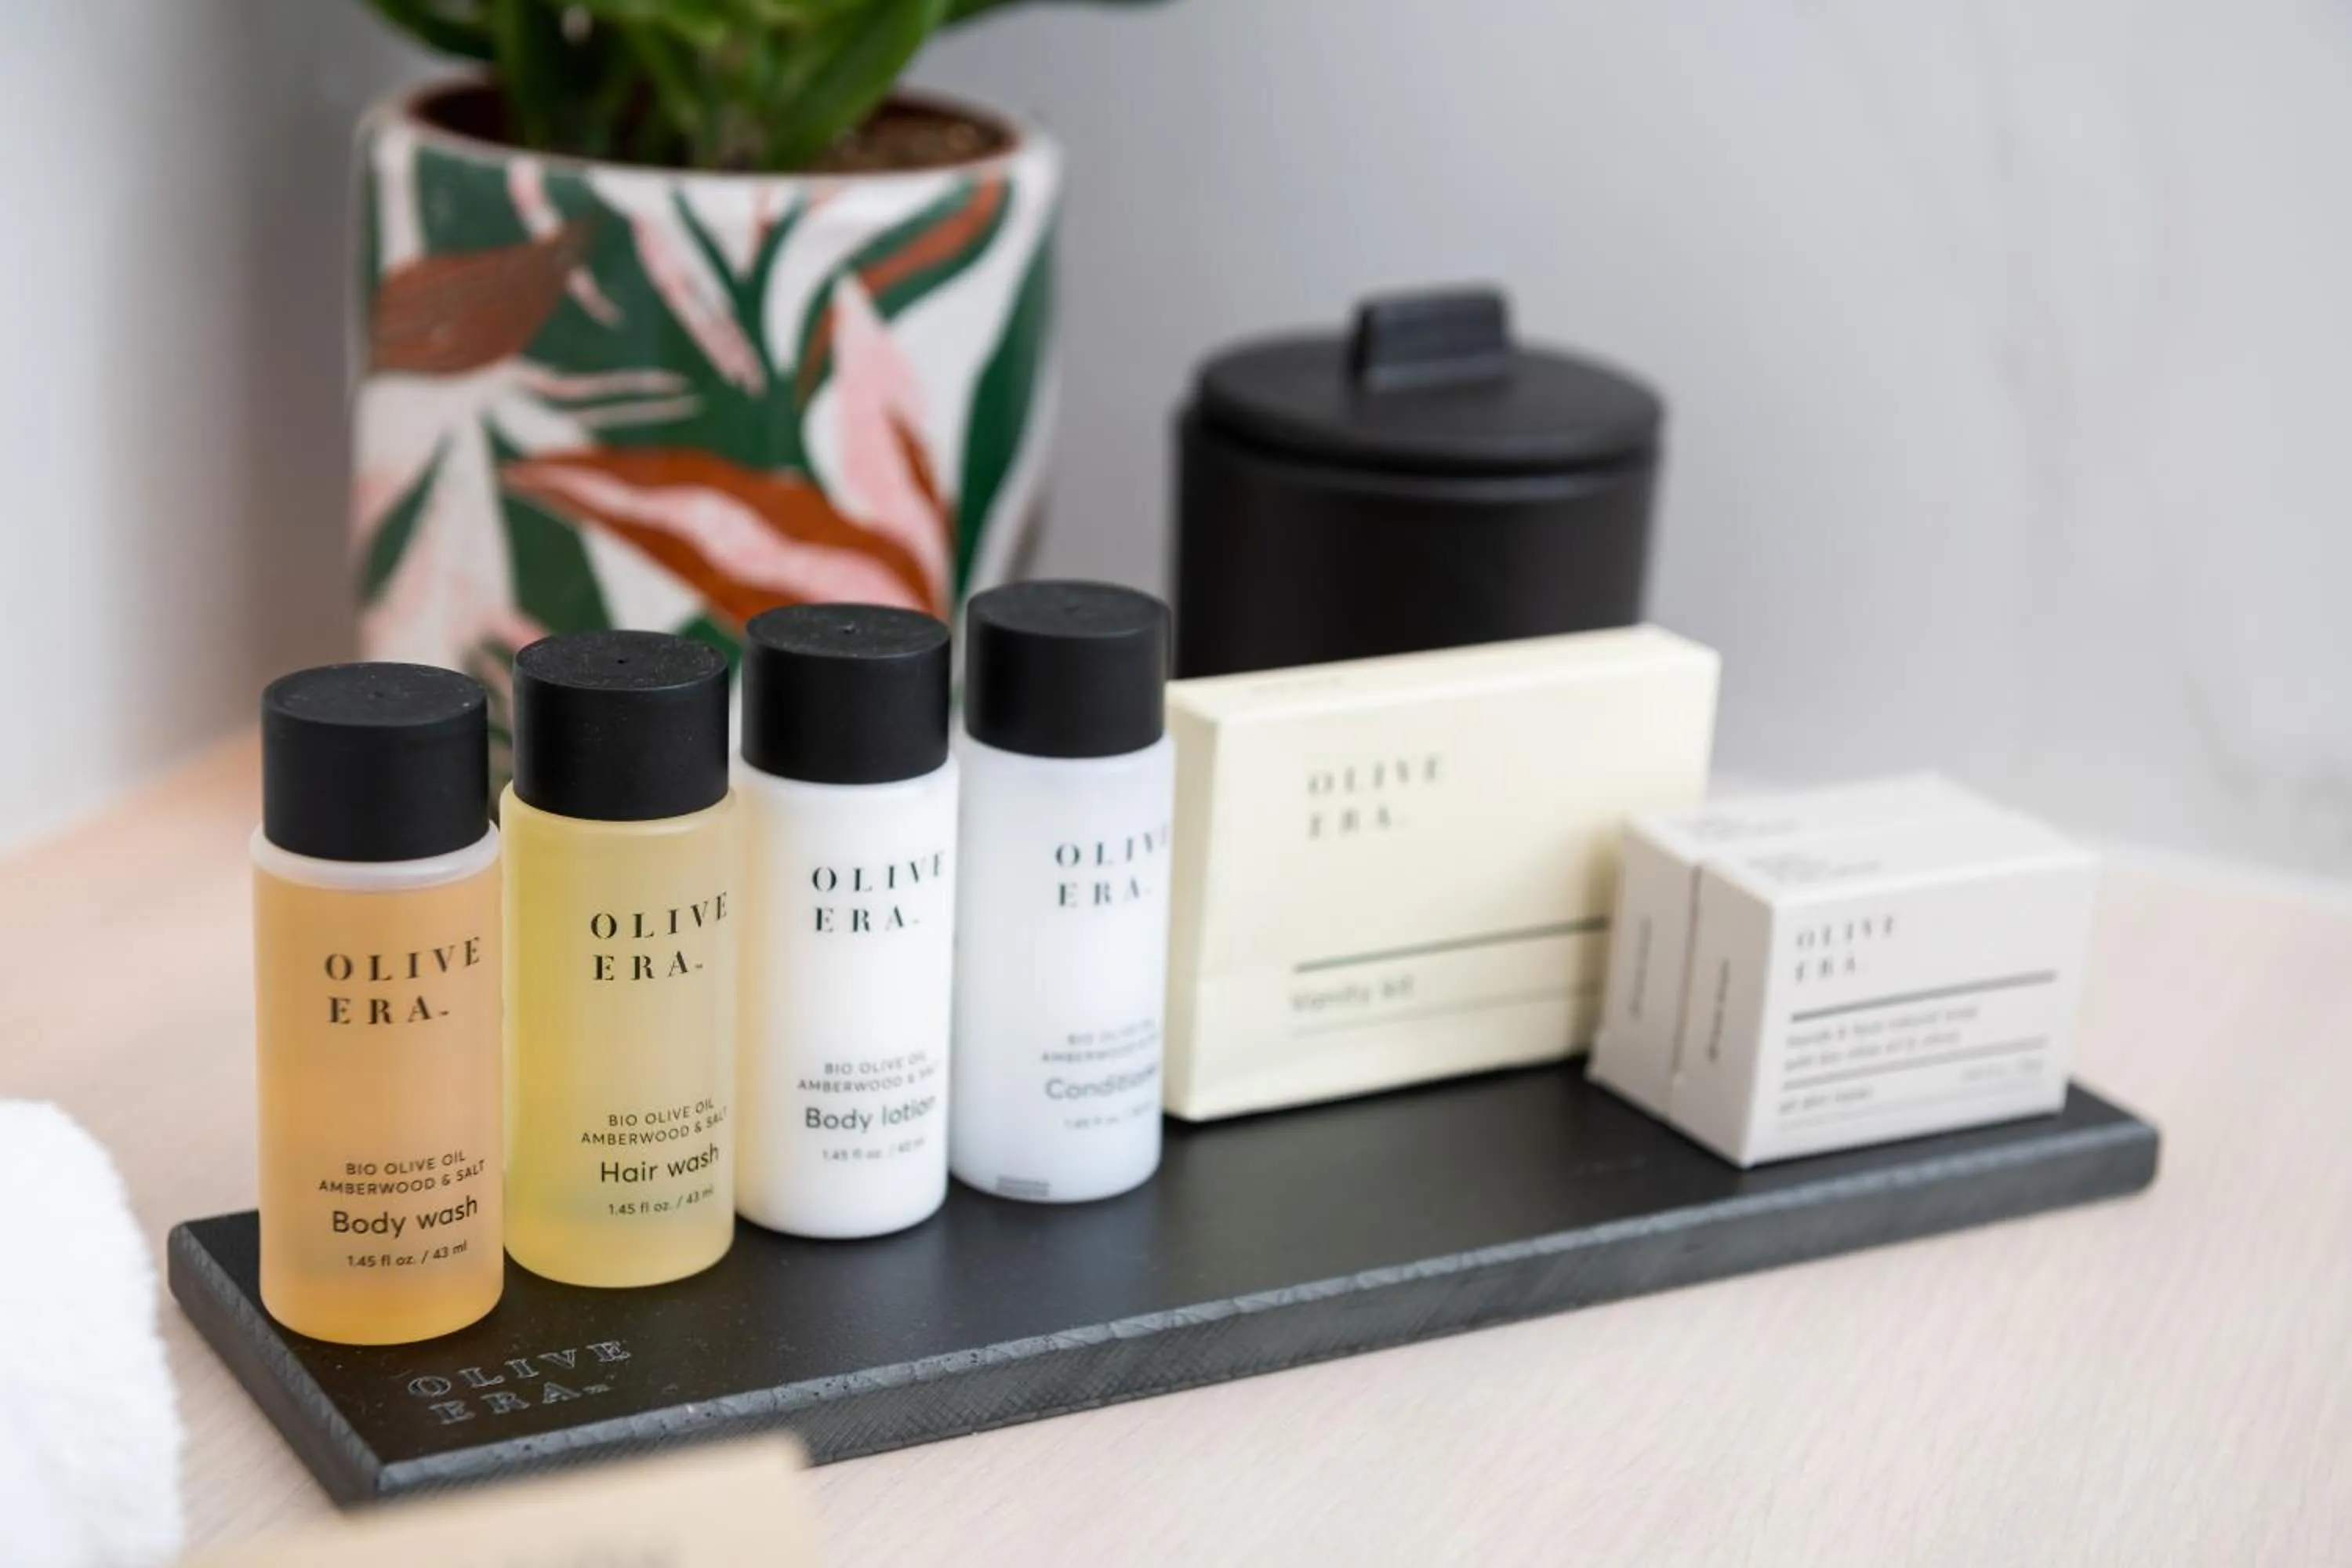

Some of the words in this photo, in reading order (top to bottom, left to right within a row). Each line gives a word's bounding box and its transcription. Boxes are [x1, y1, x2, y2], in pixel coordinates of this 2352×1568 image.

[811, 851, 944, 892] OLIVE
[590, 891, 728, 939] OLIVE
[324, 936, 480, 981] OLIVE
[824, 1063, 853, 1076] BIO
[608, 1114, 637, 1127] BIO
[644, 1105, 690, 1124] OLIVE
[695, 1099, 714, 1114] OIL
[805, 1106, 873, 1134] Body
[881, 1095, 936, 1127] lotion
[581, 1125, 689, 1145] AMBERWOOD
[694, 1121, 702, 1134] &
[318, 1178, 436, 1195] AMBERWOOD
[441, 1174, 451, 1186] &
[456, 1160, 485, 1181] SALT
[346, 1163, 377, 1175] BIO
[384, 1158, 437, 1175] OLIVE
[441, 1149, 466, 1167] OIL
[601, 1161, 658, 1183] Hair
[667, 1142, 719, 1178] wash
[332, 1210, 406, 1239] Body
[416, 1195, 477, 1229] wash
[608, 1203, 636, 1215] 1.45
[433, 1247, 449, 1259] 43
[452, 1240, 467, 1254] ml
[408, 1341, 631, 1397] OLIVE
